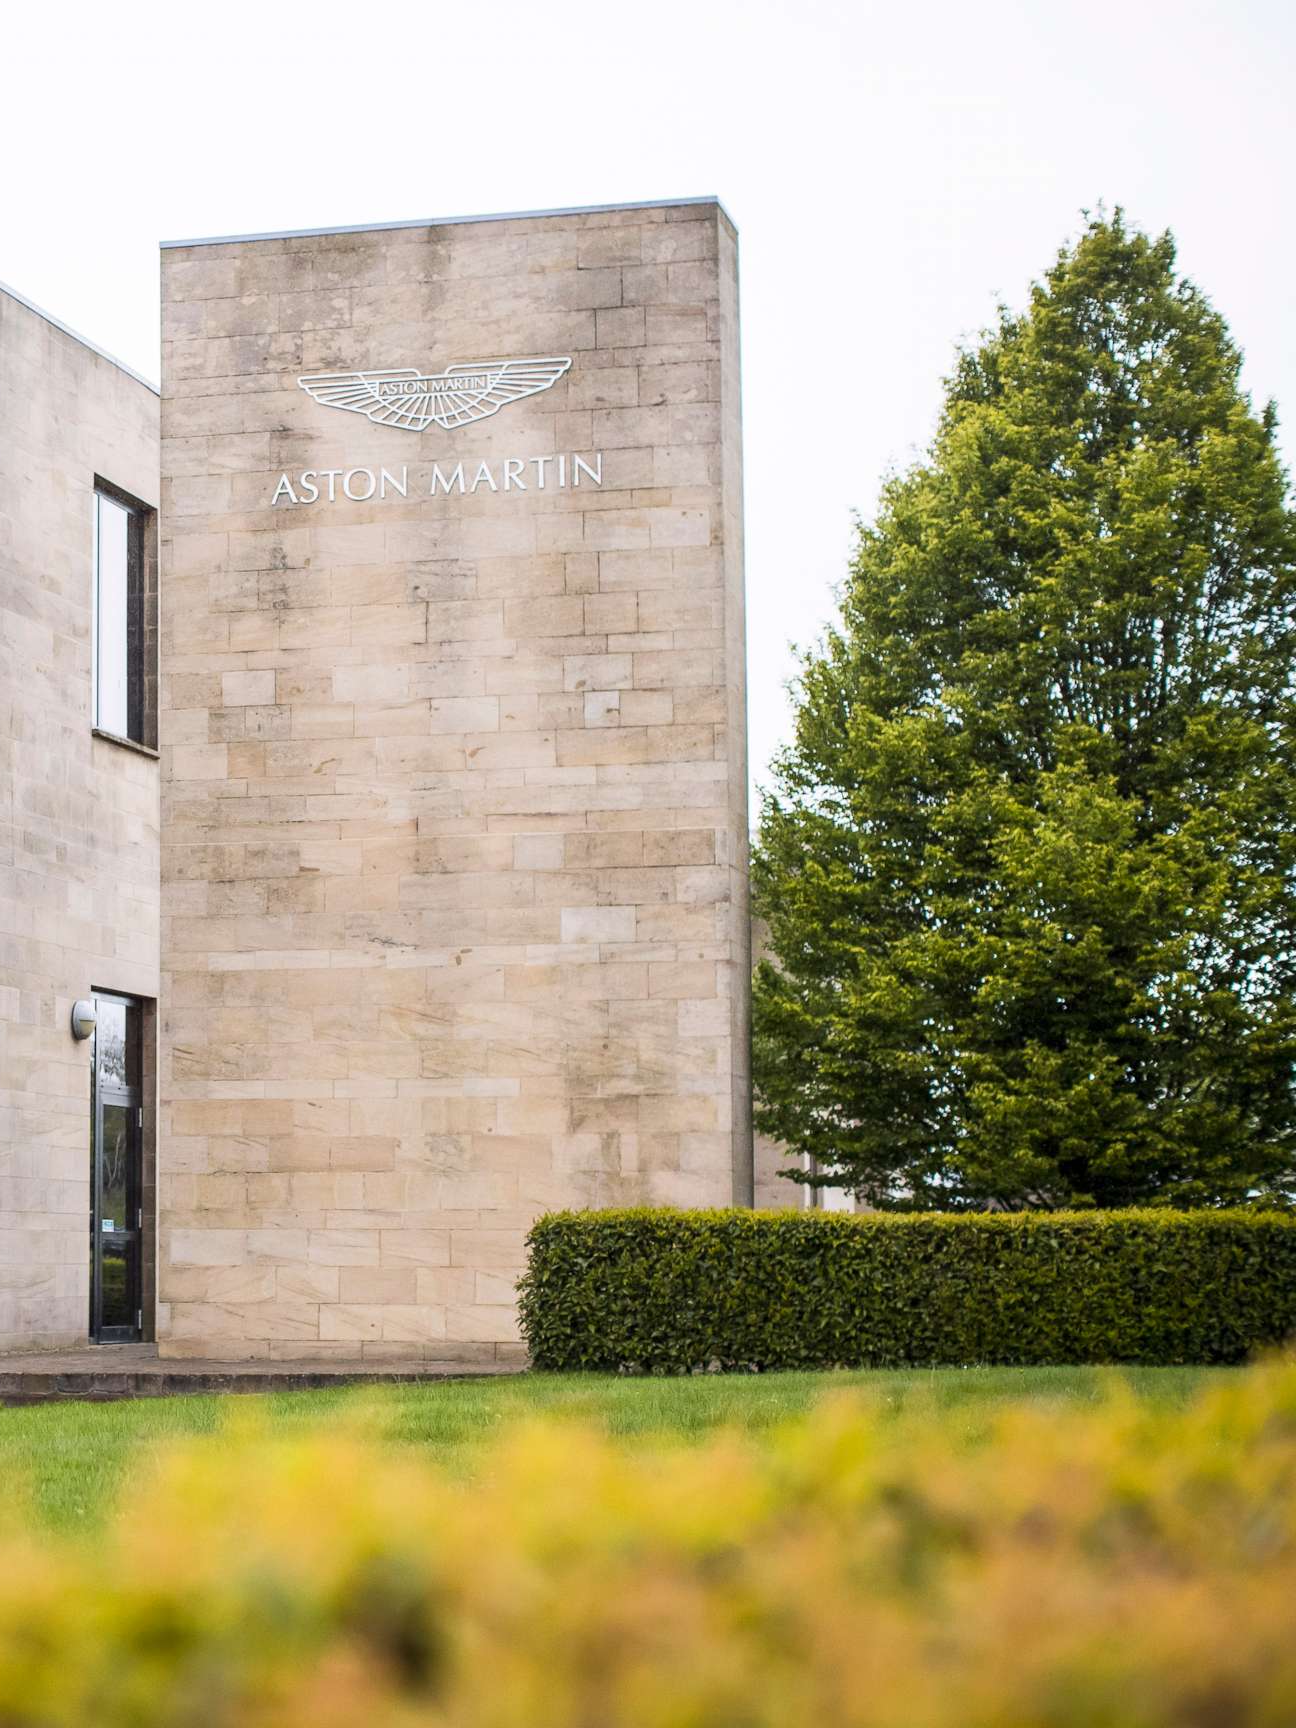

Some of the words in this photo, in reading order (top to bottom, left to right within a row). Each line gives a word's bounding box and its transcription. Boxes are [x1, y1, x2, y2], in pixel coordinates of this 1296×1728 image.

[379, 381, 428, 396] ASTON
[431, 376, 486, 393] MARTIN
[271, 466, 408, 505] ASTON
[430, 453, 603, 496] MARTIN
